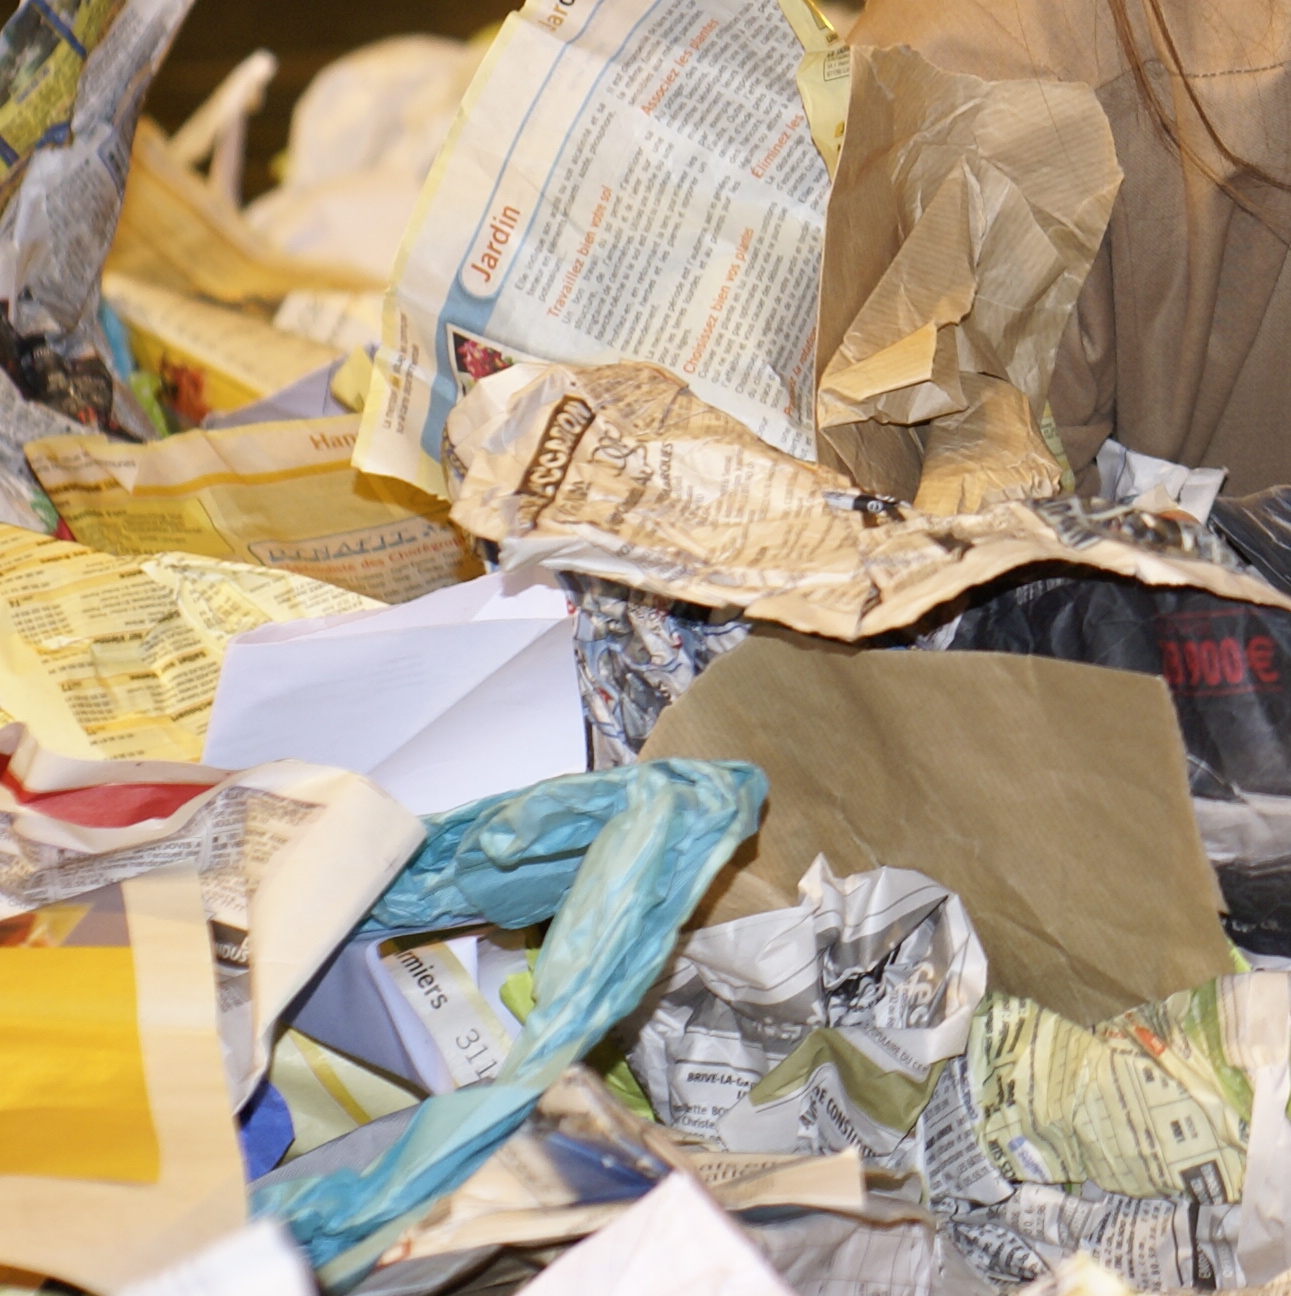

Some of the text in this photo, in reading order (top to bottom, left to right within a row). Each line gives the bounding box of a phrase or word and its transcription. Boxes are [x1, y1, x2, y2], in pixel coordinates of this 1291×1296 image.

[640, 15, 719, 116] Associez les plantes
[748, 125, 792, 182] Éliminez
[784, 110, 804, 132] les
[470, 205, 522, 284] Jardin
[546, 184, 614, 319] Travaillez bien votre sol
[679, 225, 758, 375] Choisissez bien vos plantes
[1246, 632, 1281, 683] €
[452, 1026, 500, 1081] 311
